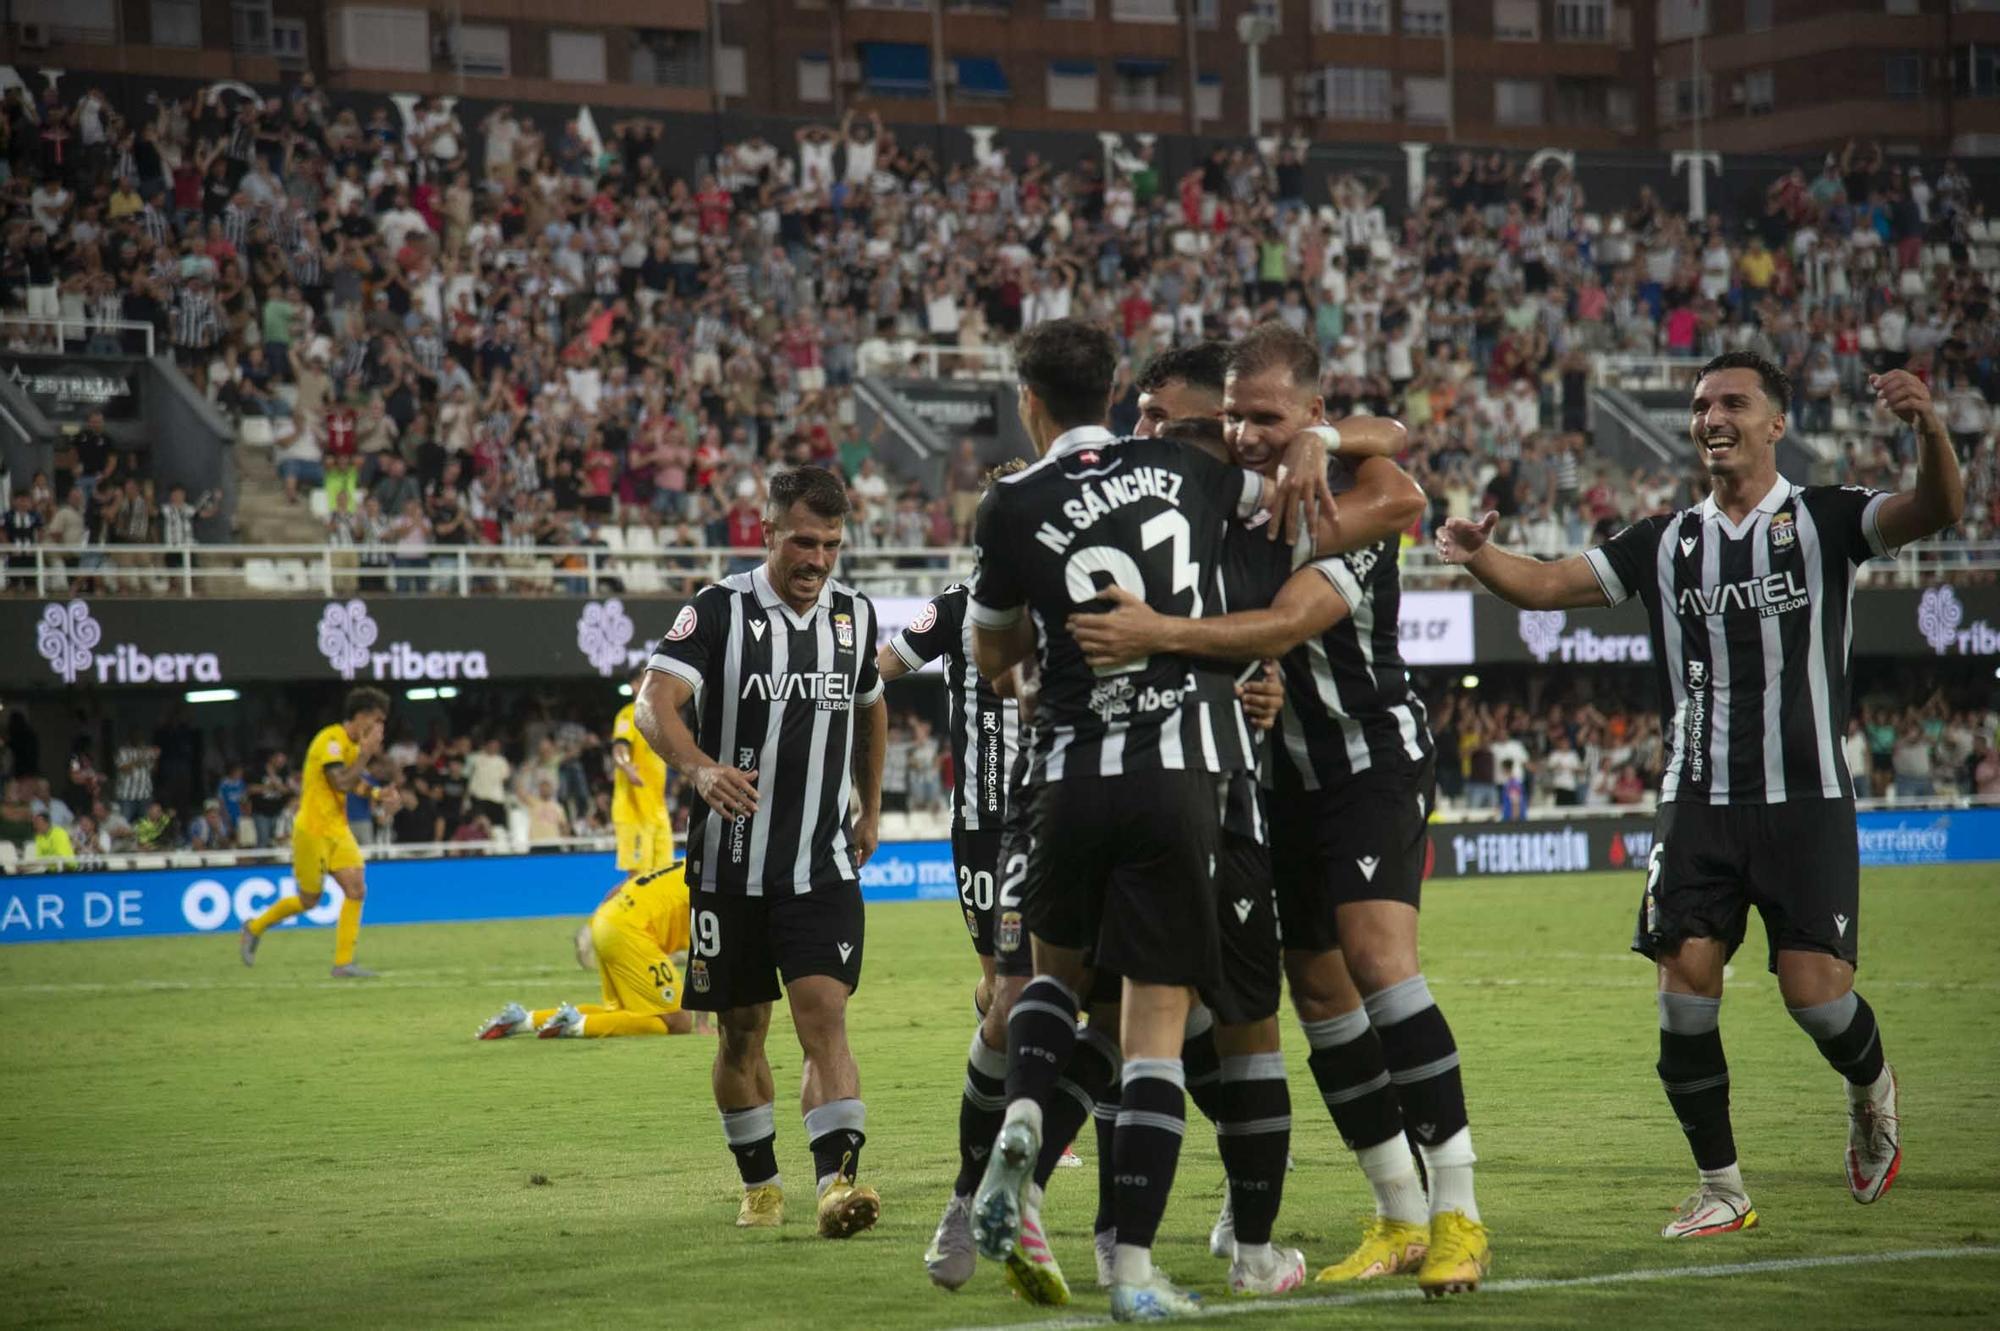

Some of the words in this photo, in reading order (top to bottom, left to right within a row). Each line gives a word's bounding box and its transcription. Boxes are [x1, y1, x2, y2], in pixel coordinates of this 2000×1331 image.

[1035, 521, 1076, 555] N.
[1063, 466, 1183, 530] SÁNCHEZ
[1679, 571, 1806, 615] AVATEL
[1760, 597, 1808, 617] TELECOM
[1561, 628, 1651, 663] ribera
[1957, 620, 2000, 655] rib
[95, 644, 222, 683] ribera
[372, 641, 488, 680] ribera
[741, 673, 853, 700] AVATEL
[1692, 691, 1705, 782] INMOHOGARES
[988, 736, 998, 812] INMOHOGARES
[732, 814, 745, 864] OGARES
[1477, 826, 1590, 873] FEDERACIÓN
[960, 865, 994, 911] 20
[0, 894, 64, 931] AR
[84, 890, 144, 928] DE
[690, 907, 721, 957] 19
[648, 962, 673, 987] 20
